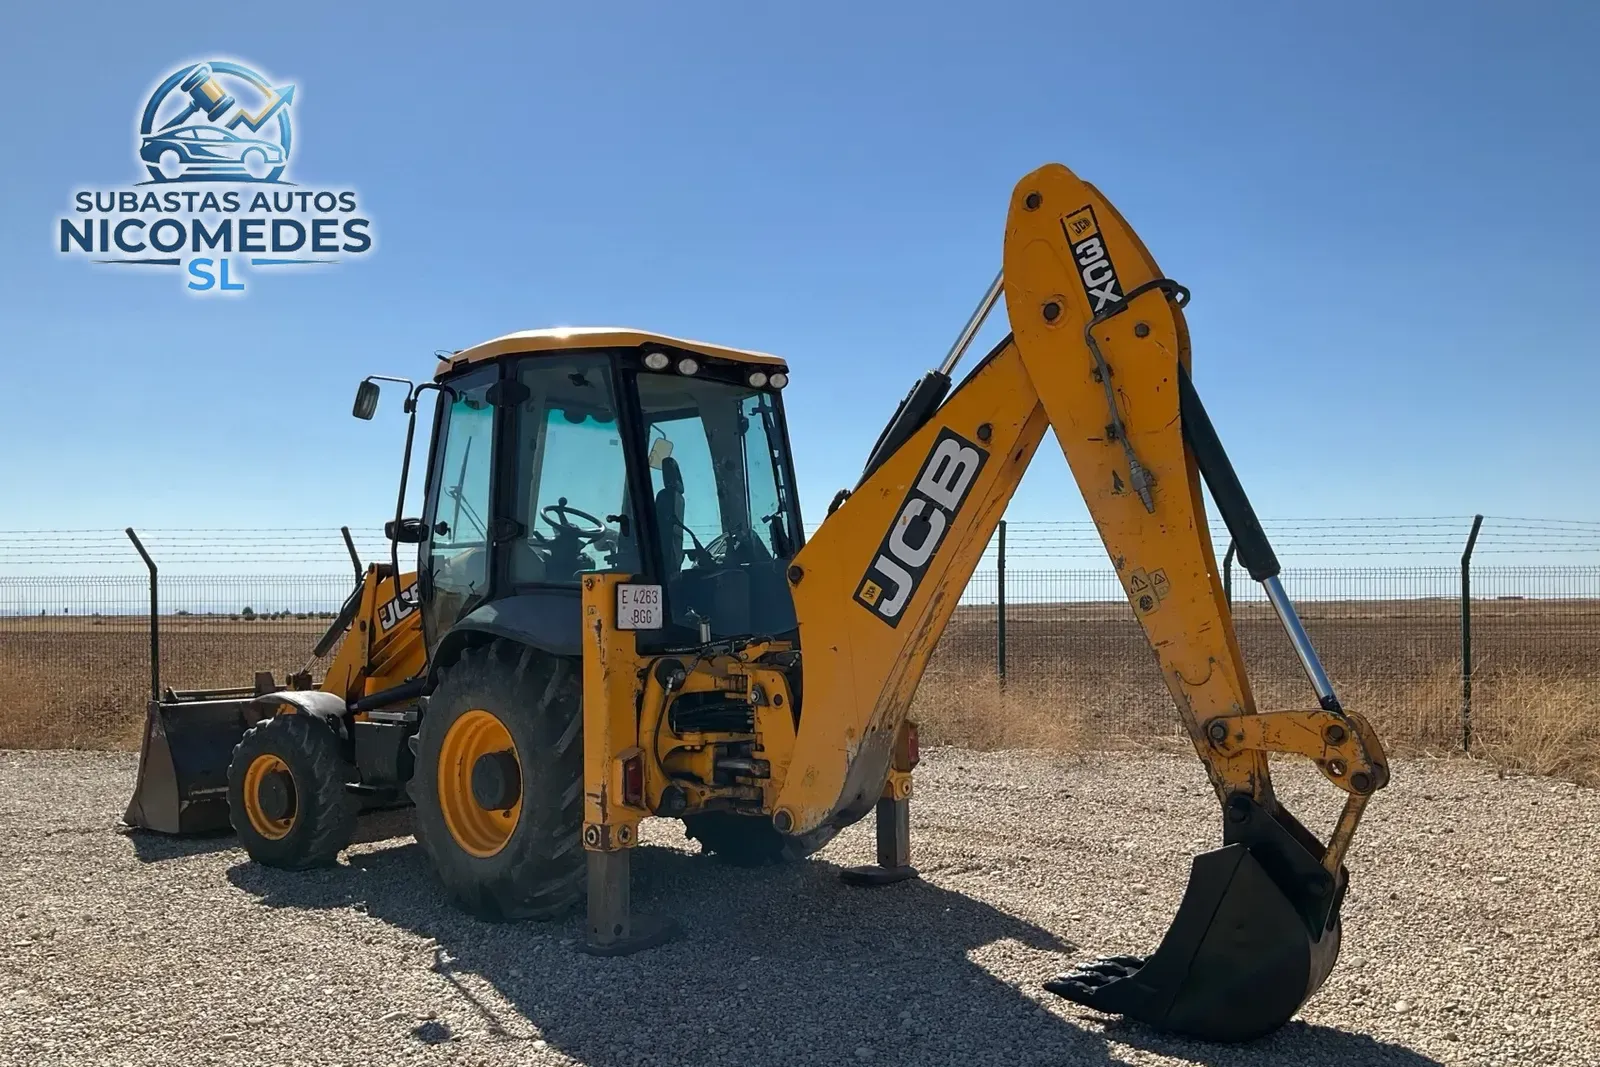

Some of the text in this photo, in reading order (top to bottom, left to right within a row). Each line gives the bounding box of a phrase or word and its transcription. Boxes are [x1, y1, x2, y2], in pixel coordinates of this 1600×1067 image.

[1075, 237, 1122, 312] 3CX
[874, 438, 980, 618] JCB
[622, 589, 658, 605] E 4263
[633, 609, 652, 624] BGG
